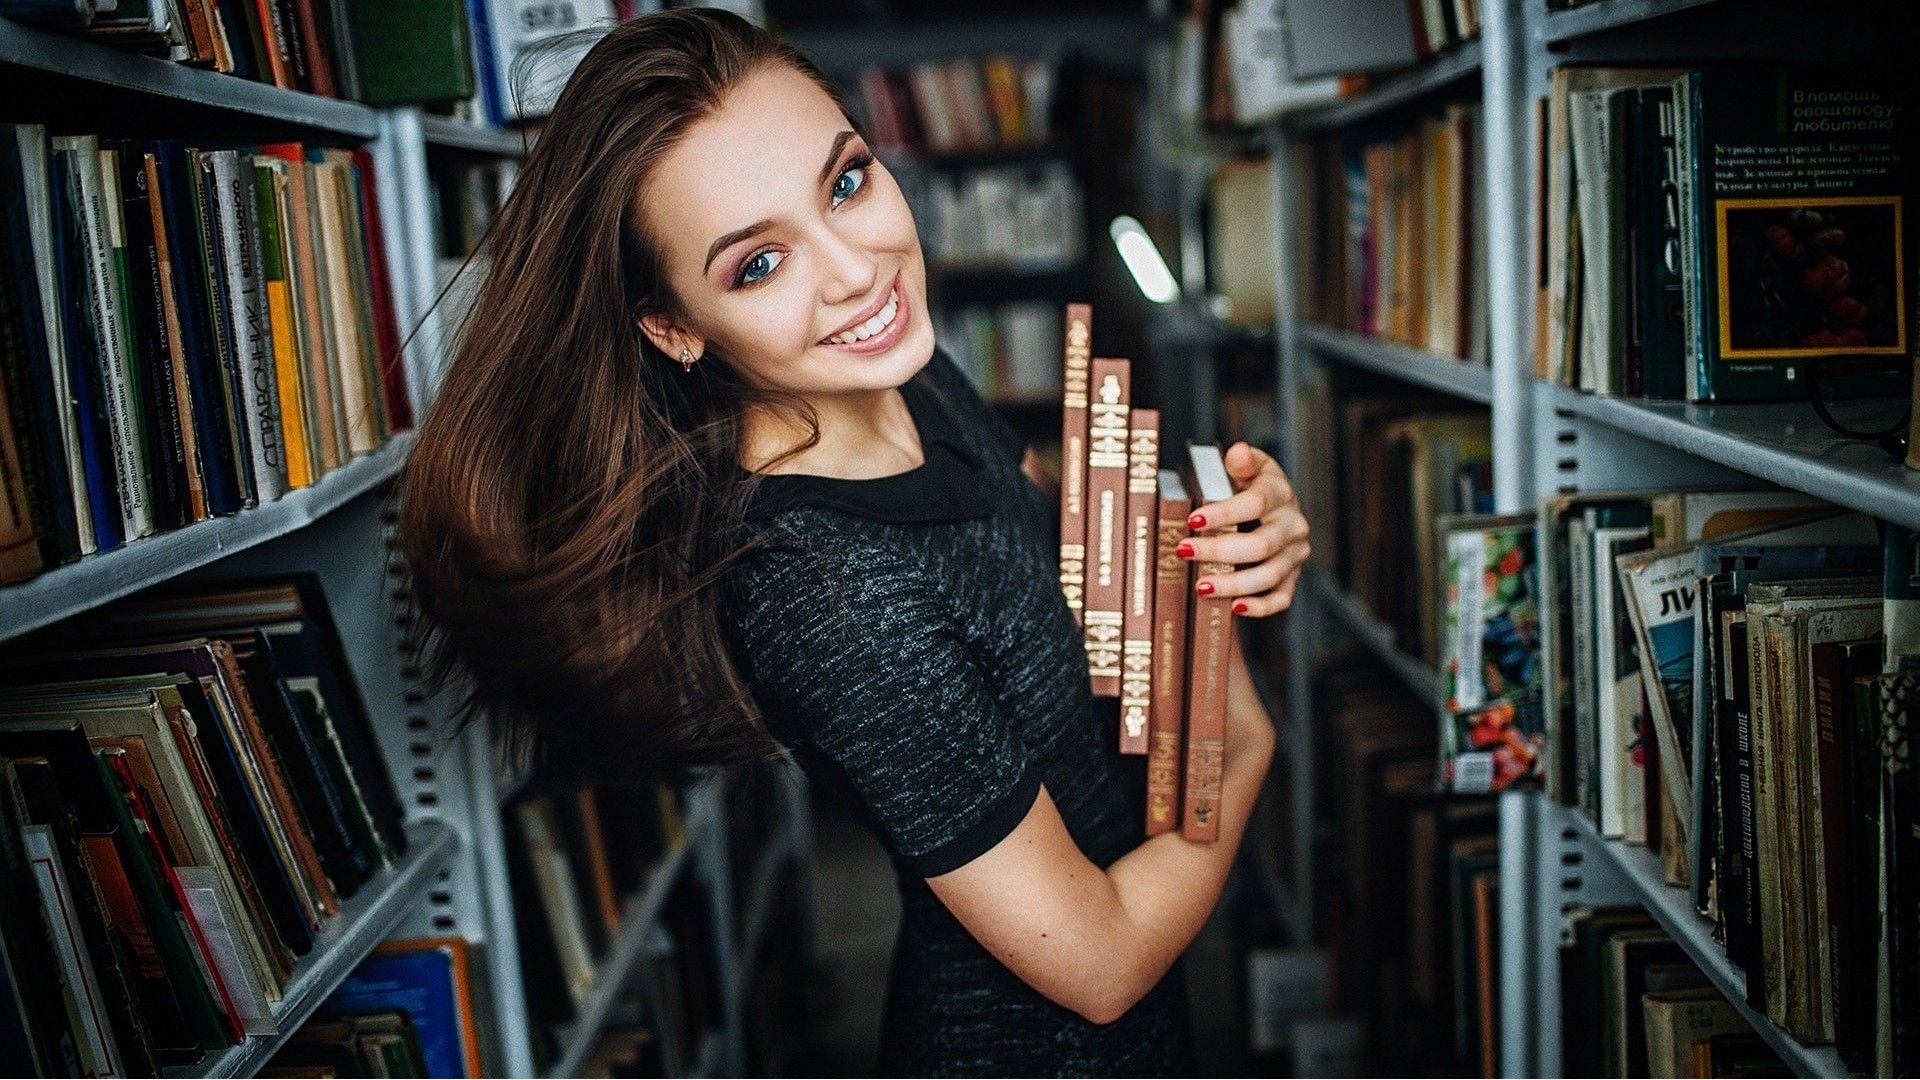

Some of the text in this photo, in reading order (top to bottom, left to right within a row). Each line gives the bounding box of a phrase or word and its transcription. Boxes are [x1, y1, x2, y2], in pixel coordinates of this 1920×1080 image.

[1793, 118, 1895, 132] любителю
[1807, 90, 1881, 104] помощь
[92, 195, 106, 250] ветеринарии
[100, 262, 114, 310] препаратов
[109, 314, 123, 378] лекарственных
[148, 245, 184, 463] ВЕТЕРИНАРНАЯ ТОКСИКОЛОГИЯ
[210, 284, 230, 369] АНТИБИОТИКИ
[118, 383, 132, 446] использование
[245, 305, 279, 468] СПРАВОЧНИК
[125, 450, 142, 509] Рациональное
[1737, 711, 1748, 752] ШКОЛЕ
[1752, 636, 1767, 794] УЧЕБНАЯ КНИГА ЦВЕТОВОДА
[1739, 758, 1749, 767] В
[1740, 773, 1753, 859] ЦВЕТОВОДСТВО
